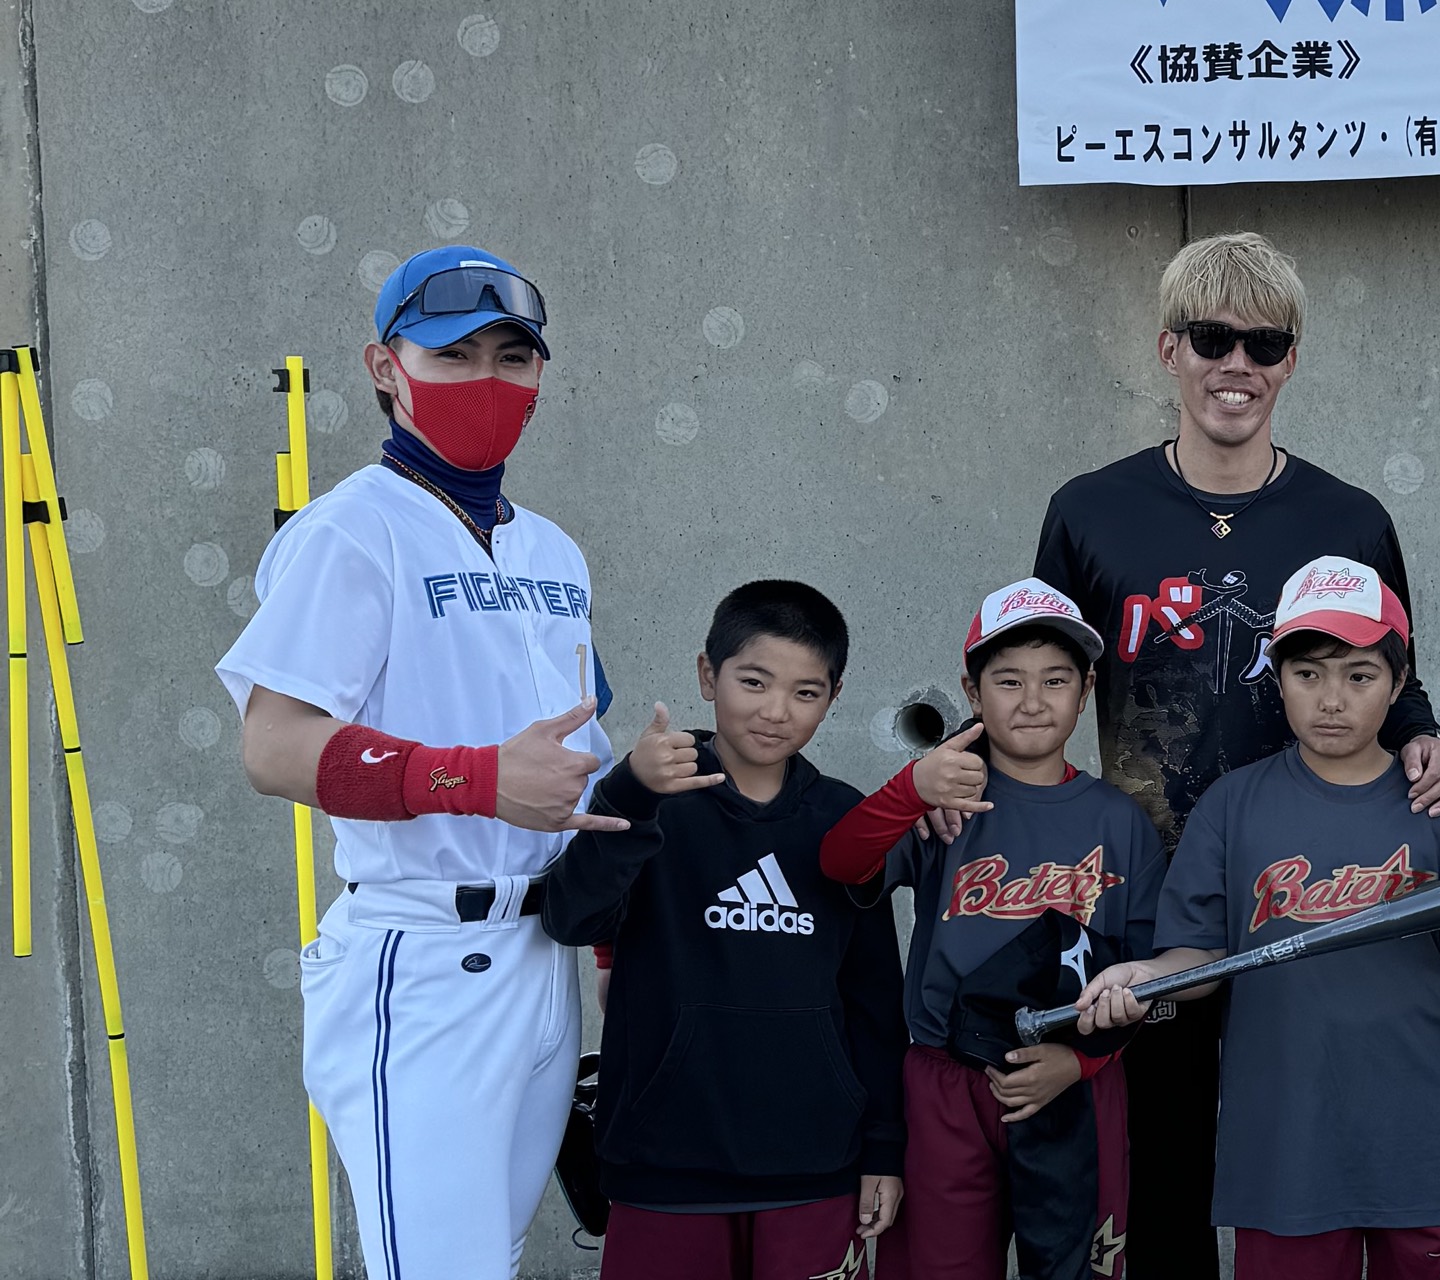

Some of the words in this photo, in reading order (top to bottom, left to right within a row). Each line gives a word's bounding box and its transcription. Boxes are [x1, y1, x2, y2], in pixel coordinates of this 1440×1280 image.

[1129, 39, 1361, 84] 《協賛企業》
[423, 572, 590, 620] FIGHTER
[942, 850, 1104, 922] Baten
[1249, 854, 1408, 933] Baten
[704, 903, 815, 936] adidas
